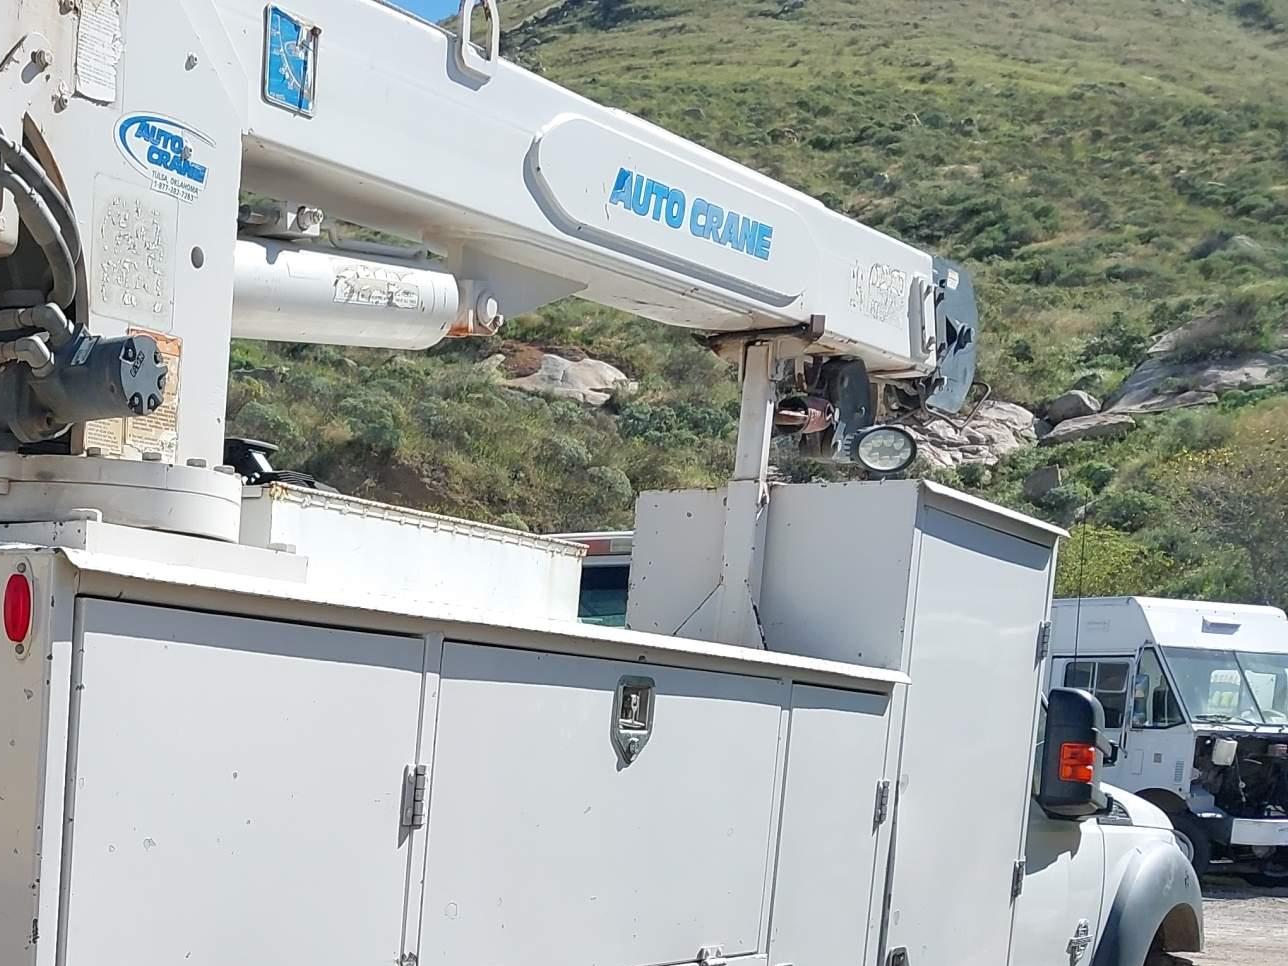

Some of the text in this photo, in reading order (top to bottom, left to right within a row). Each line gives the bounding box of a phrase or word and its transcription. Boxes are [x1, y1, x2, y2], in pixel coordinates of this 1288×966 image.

[135, 120, 185, 155] AUTO
[147, 144, 207, 184] CRANE
[170, 177, 199, 195] OKLAHOMA
[609, 168, 773, 261] AUTO CRANE
